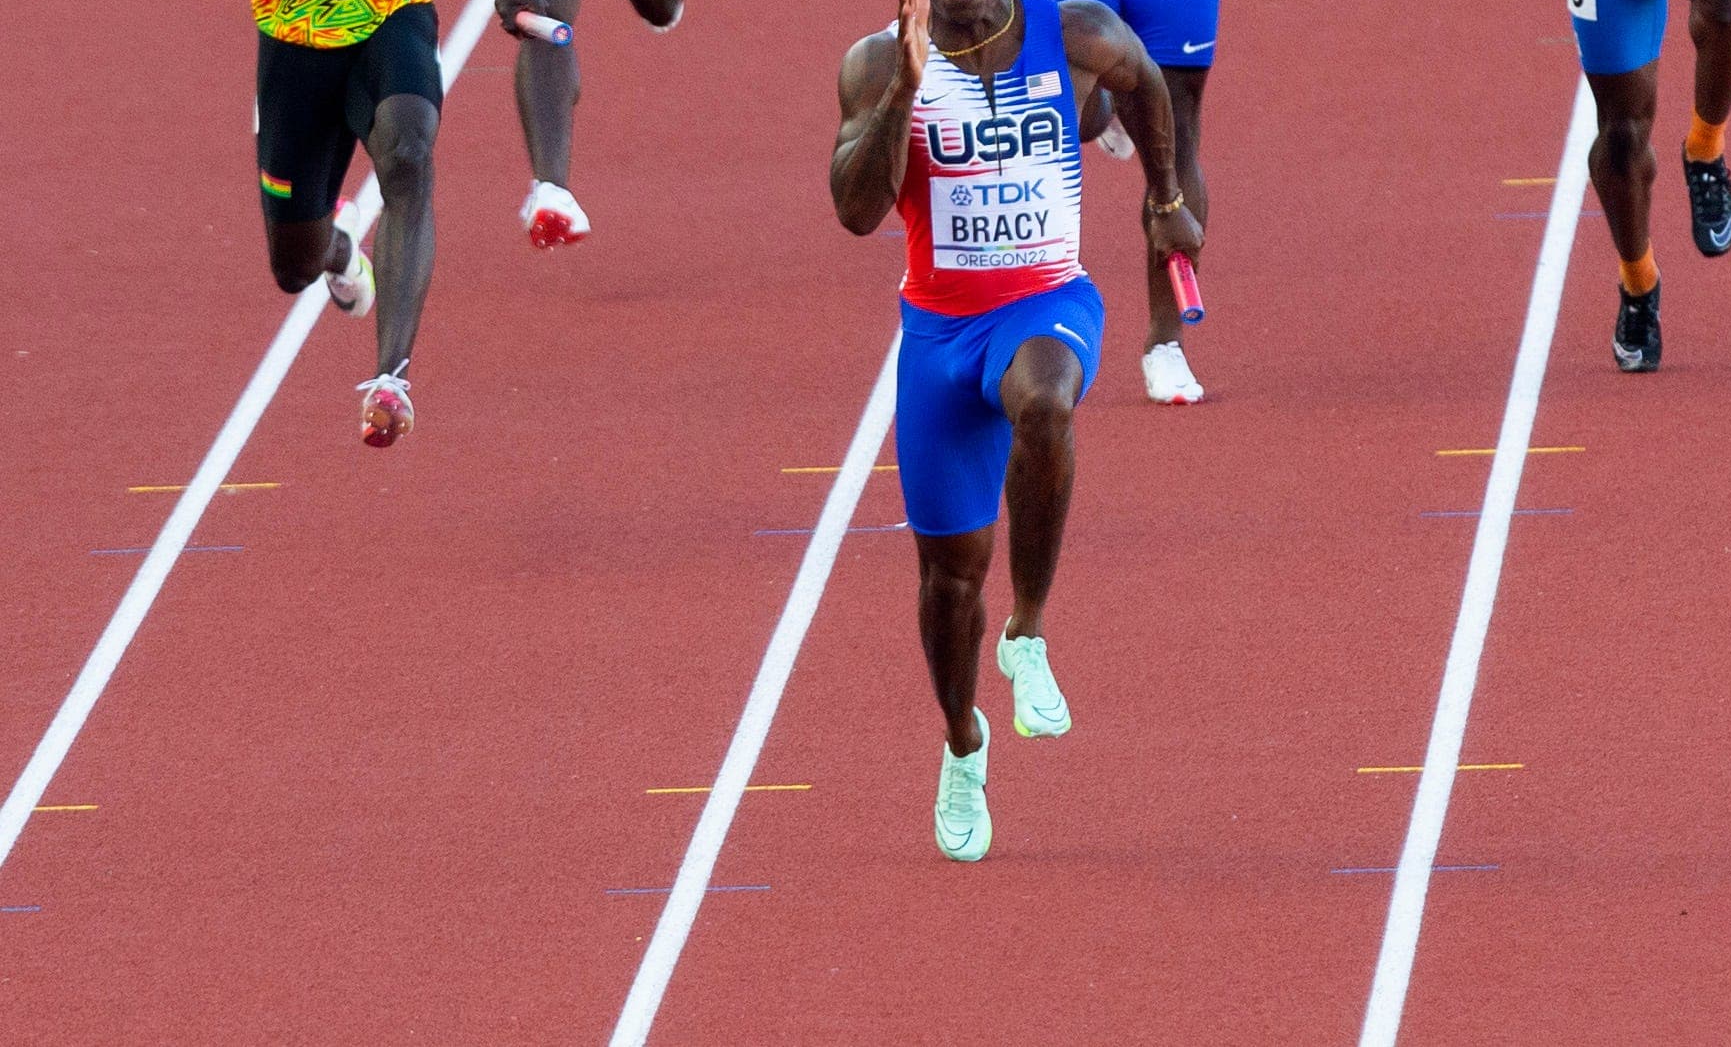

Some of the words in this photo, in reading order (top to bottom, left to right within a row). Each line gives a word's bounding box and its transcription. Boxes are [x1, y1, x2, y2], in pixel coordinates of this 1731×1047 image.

[926, 109, 1062, 166] USA
[973, 178, 1046, 206] TDK
[952, 209, 1050, 242] BRACY
[956, 249, 1048, 267] OREGON22
